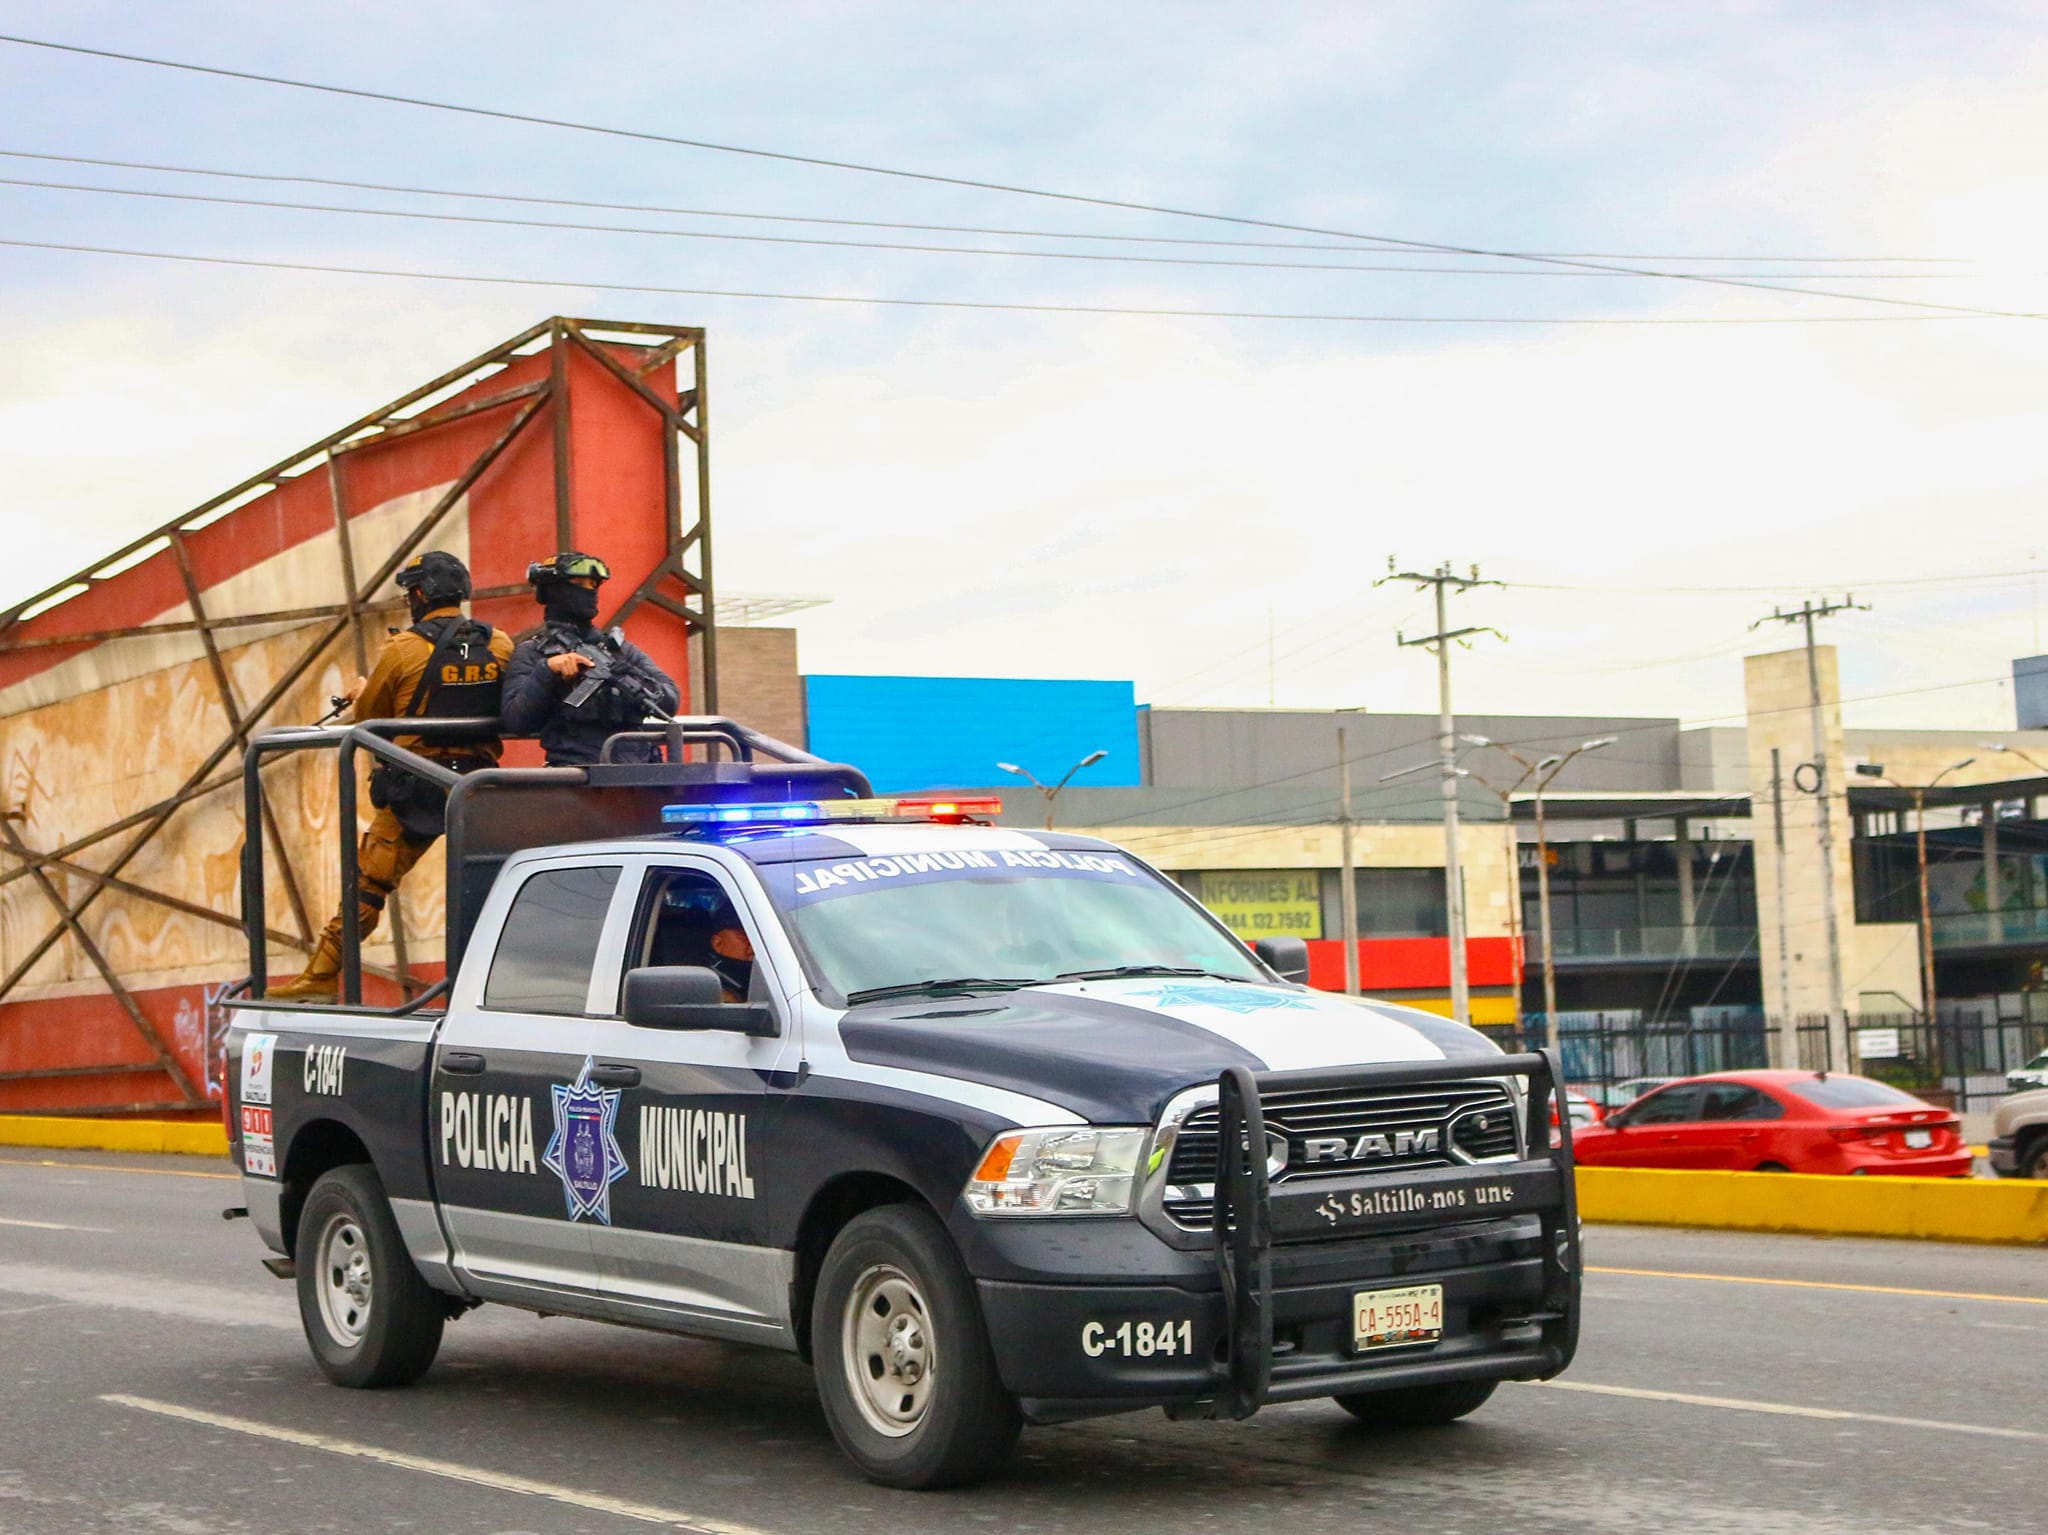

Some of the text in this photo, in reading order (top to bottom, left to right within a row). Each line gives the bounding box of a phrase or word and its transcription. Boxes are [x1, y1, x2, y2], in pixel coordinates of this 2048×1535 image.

[1296, 877, 1318, 901] AL
[304, 1044, 347, 1096] C-1841
[243, 1110, 271, 1133] 911
[640, 1105, 755, 1199] MUNICIPAL
[1304, 1128, 1440, 1164] RAM
[1351, 1185, 1512, 1217] Saltillo nos une
[1359, 1301, 1439, 1332] CA-555A-4
[1082, 1320, 1192, 1357] C-1841
